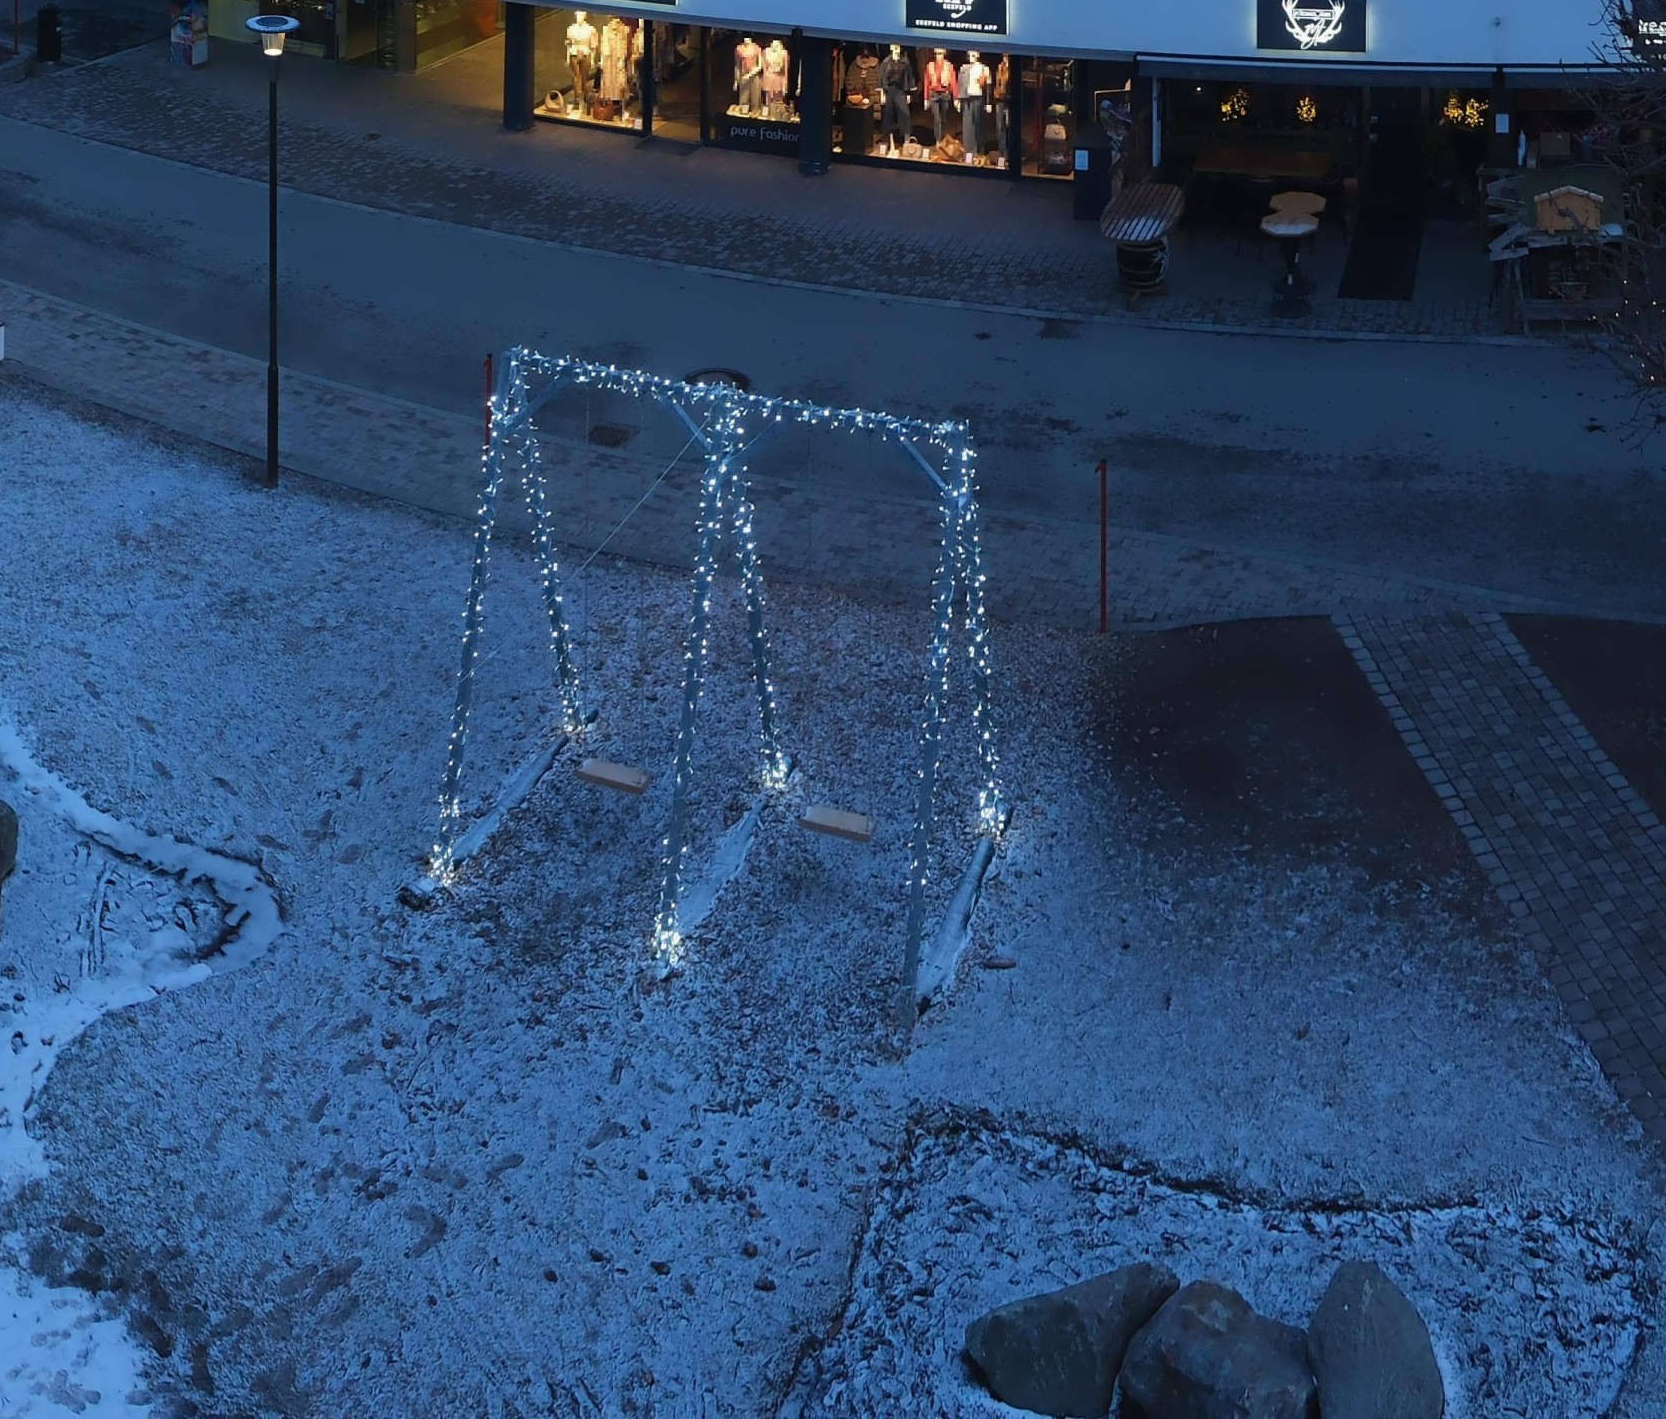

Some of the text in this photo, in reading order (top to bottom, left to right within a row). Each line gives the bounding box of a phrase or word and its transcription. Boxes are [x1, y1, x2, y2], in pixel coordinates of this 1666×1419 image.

[942, 3, 972, 11] SEEFELD
[915, 19, 998, 32] SEEFELD SHOPPING APP
[730, 126, 757, 138] pure
